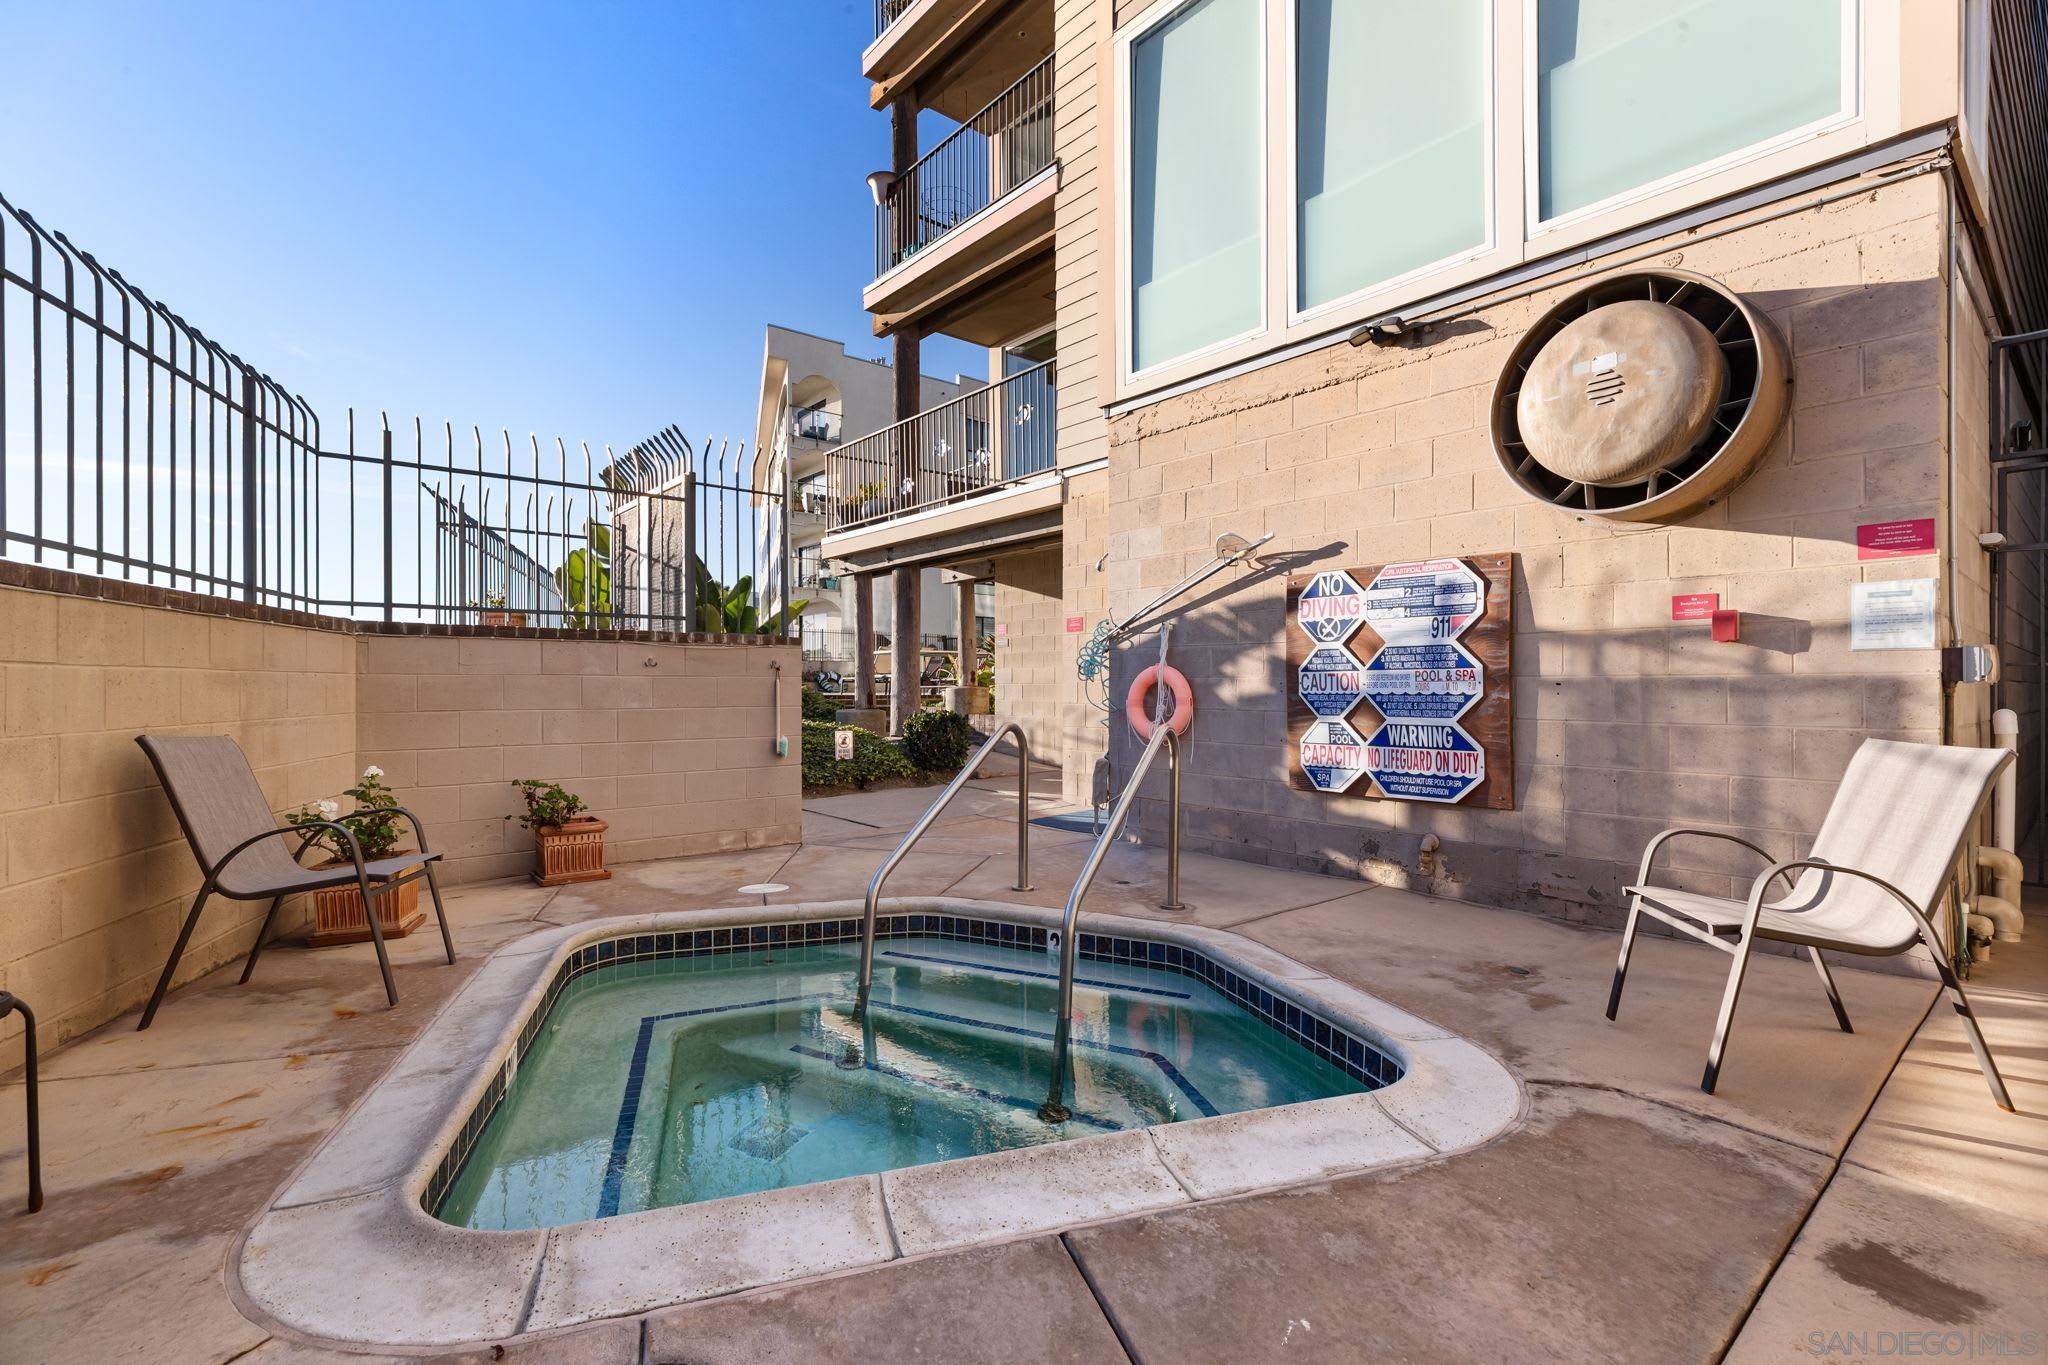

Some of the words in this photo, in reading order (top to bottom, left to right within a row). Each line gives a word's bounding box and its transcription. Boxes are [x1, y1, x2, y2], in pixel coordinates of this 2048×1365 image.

[1318, 575, 1344, 596] NO
[1405, 588, 1411, 596] 2
[1300, 596, 1360, 618] DIVING
[1367, 600, 1372, 608] 3
[1404, 609, 1410, 617] 4
[1431, 616, 1451, 638] 911
[1301, 673, 1360, 691] CAUTION
[1415, 670, 1442, 681] POOL
[1446, 670, 1452, 681] &
[1455, 670, 1476, 681] SPA
[1415, 682, 1430, 691] HOURS
[1452, 682, 1458, 691] TO
[1330, 734, 1353, 744] POOL
[1387, 724, 1453, 748] WARNING
[1304, 745, 1361, 766] CAPACITY
[1368, 748, 1380, 768] NO
[1384, 748, 1432, 771] LIFEGUARD
[1436, 751, 1450, 772] ON
[1453, 752, 1479, 774] DUTY
[1422, 787, 1449, 796] SUPERVISION
